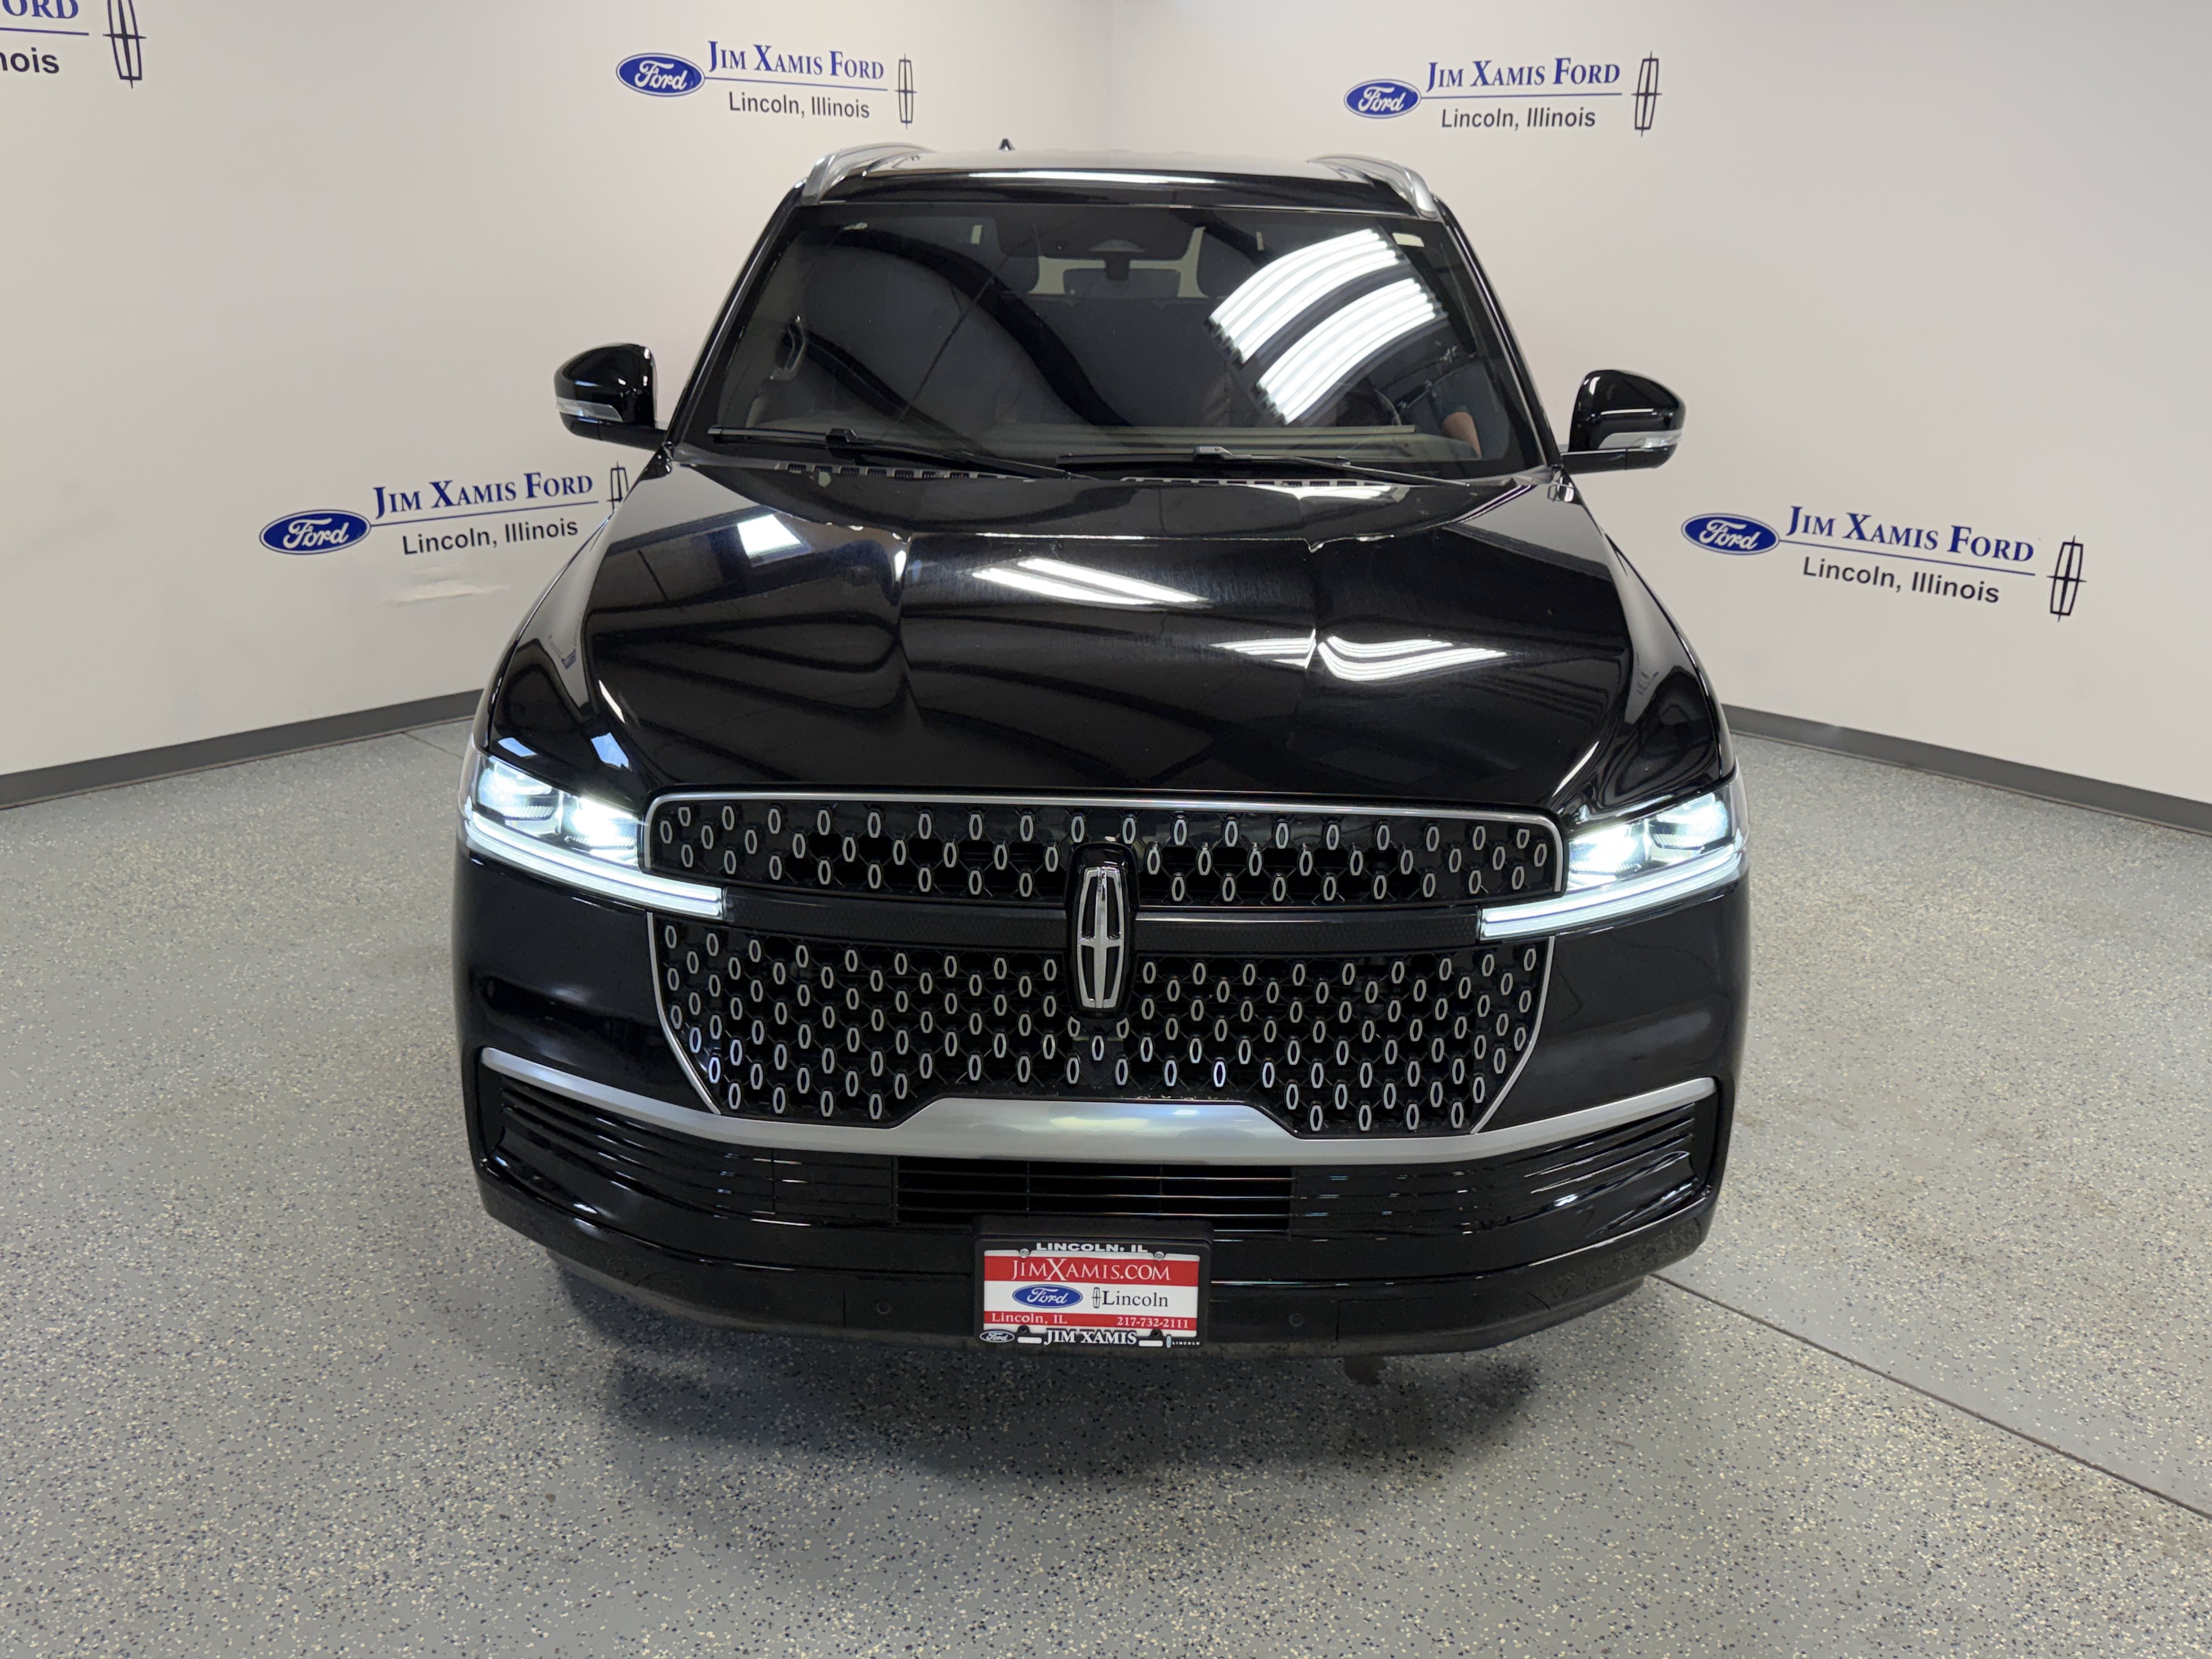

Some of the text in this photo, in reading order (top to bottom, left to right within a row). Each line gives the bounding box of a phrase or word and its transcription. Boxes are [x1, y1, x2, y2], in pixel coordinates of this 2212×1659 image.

[2, 0, 78, 19] ORD
[708, 41, 884, 79] JIM XAMIS FORD
[634, 60, 687, 91] Ford
[1426, 58, 1620, 92] JIM XAMIS FORD
[729, 91, 870, 119] Lincoln, Illinois
[1358, 87, 1404, 112] Ford
[1442, 107, 1596, 131] Lincoln, Illinois
[373, 471, 593, 519] JIM XAMIS FORD
[283, 517, 348, 548] Ford
[403, 518, 578, 555] Lincoln, Illinois
[1699, 519, 1760, 550] Ford
[1786, 506, 2034, 562] JIM XAMIS FORD
[1803, 556, 2000, 603] Lincoln, Illinois
[1036, 1242, 1148, 1252] LINCOLN, IL
[1011, 1259, 1172, 1281] JIMXAMIS.COM
[1027, 1289, 1067, 1304] Ford
[1102, 1290, 1169, 1307] Lincoln
[992, 1313, 1068, 1324] Lincoln, IL
[1117, 1317, 1188, 1328] 217-732-2111
[986, 1332, 1008, 1341] Ford
[1043, 1330, 1137, 1345] JIM XAMIS
